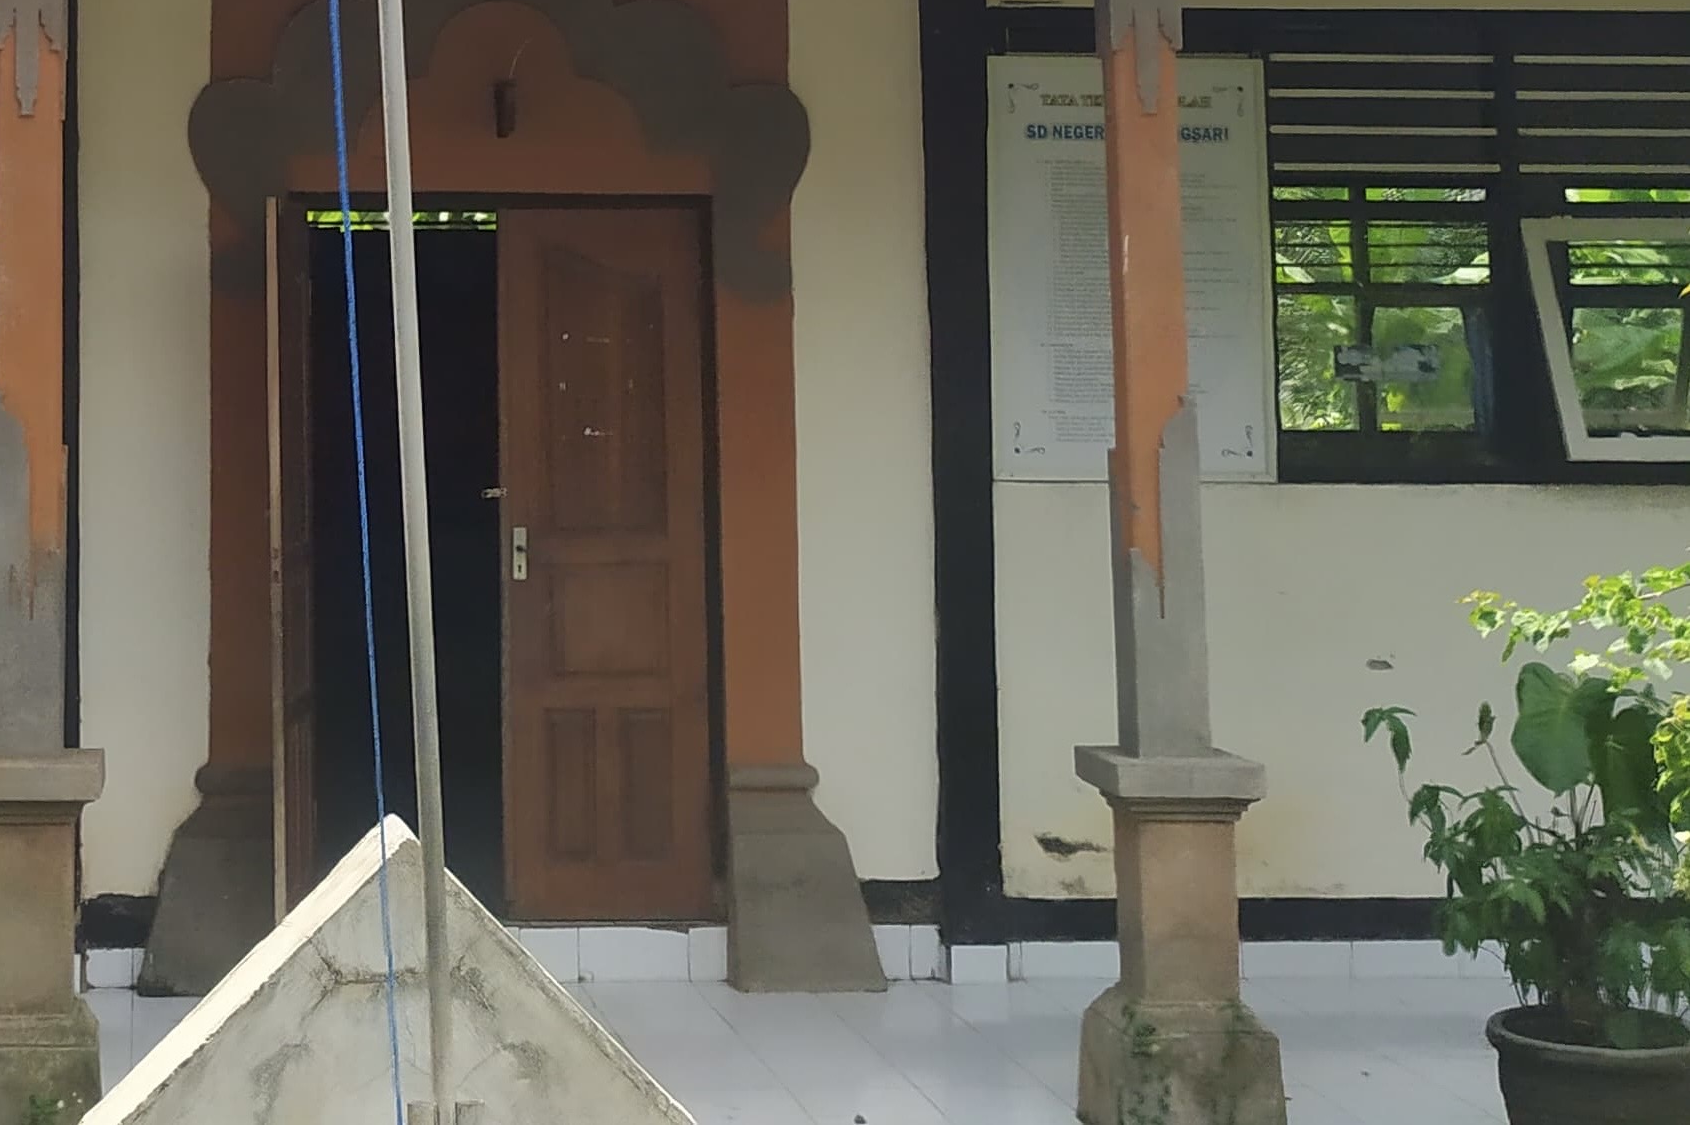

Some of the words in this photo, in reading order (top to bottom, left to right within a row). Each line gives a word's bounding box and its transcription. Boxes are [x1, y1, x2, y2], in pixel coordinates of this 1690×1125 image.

[1026, 124, 1048, 139] SD
[1052, 124, 1106, 140] NEGER
[1179, 126, 1229, 142] GSARI
